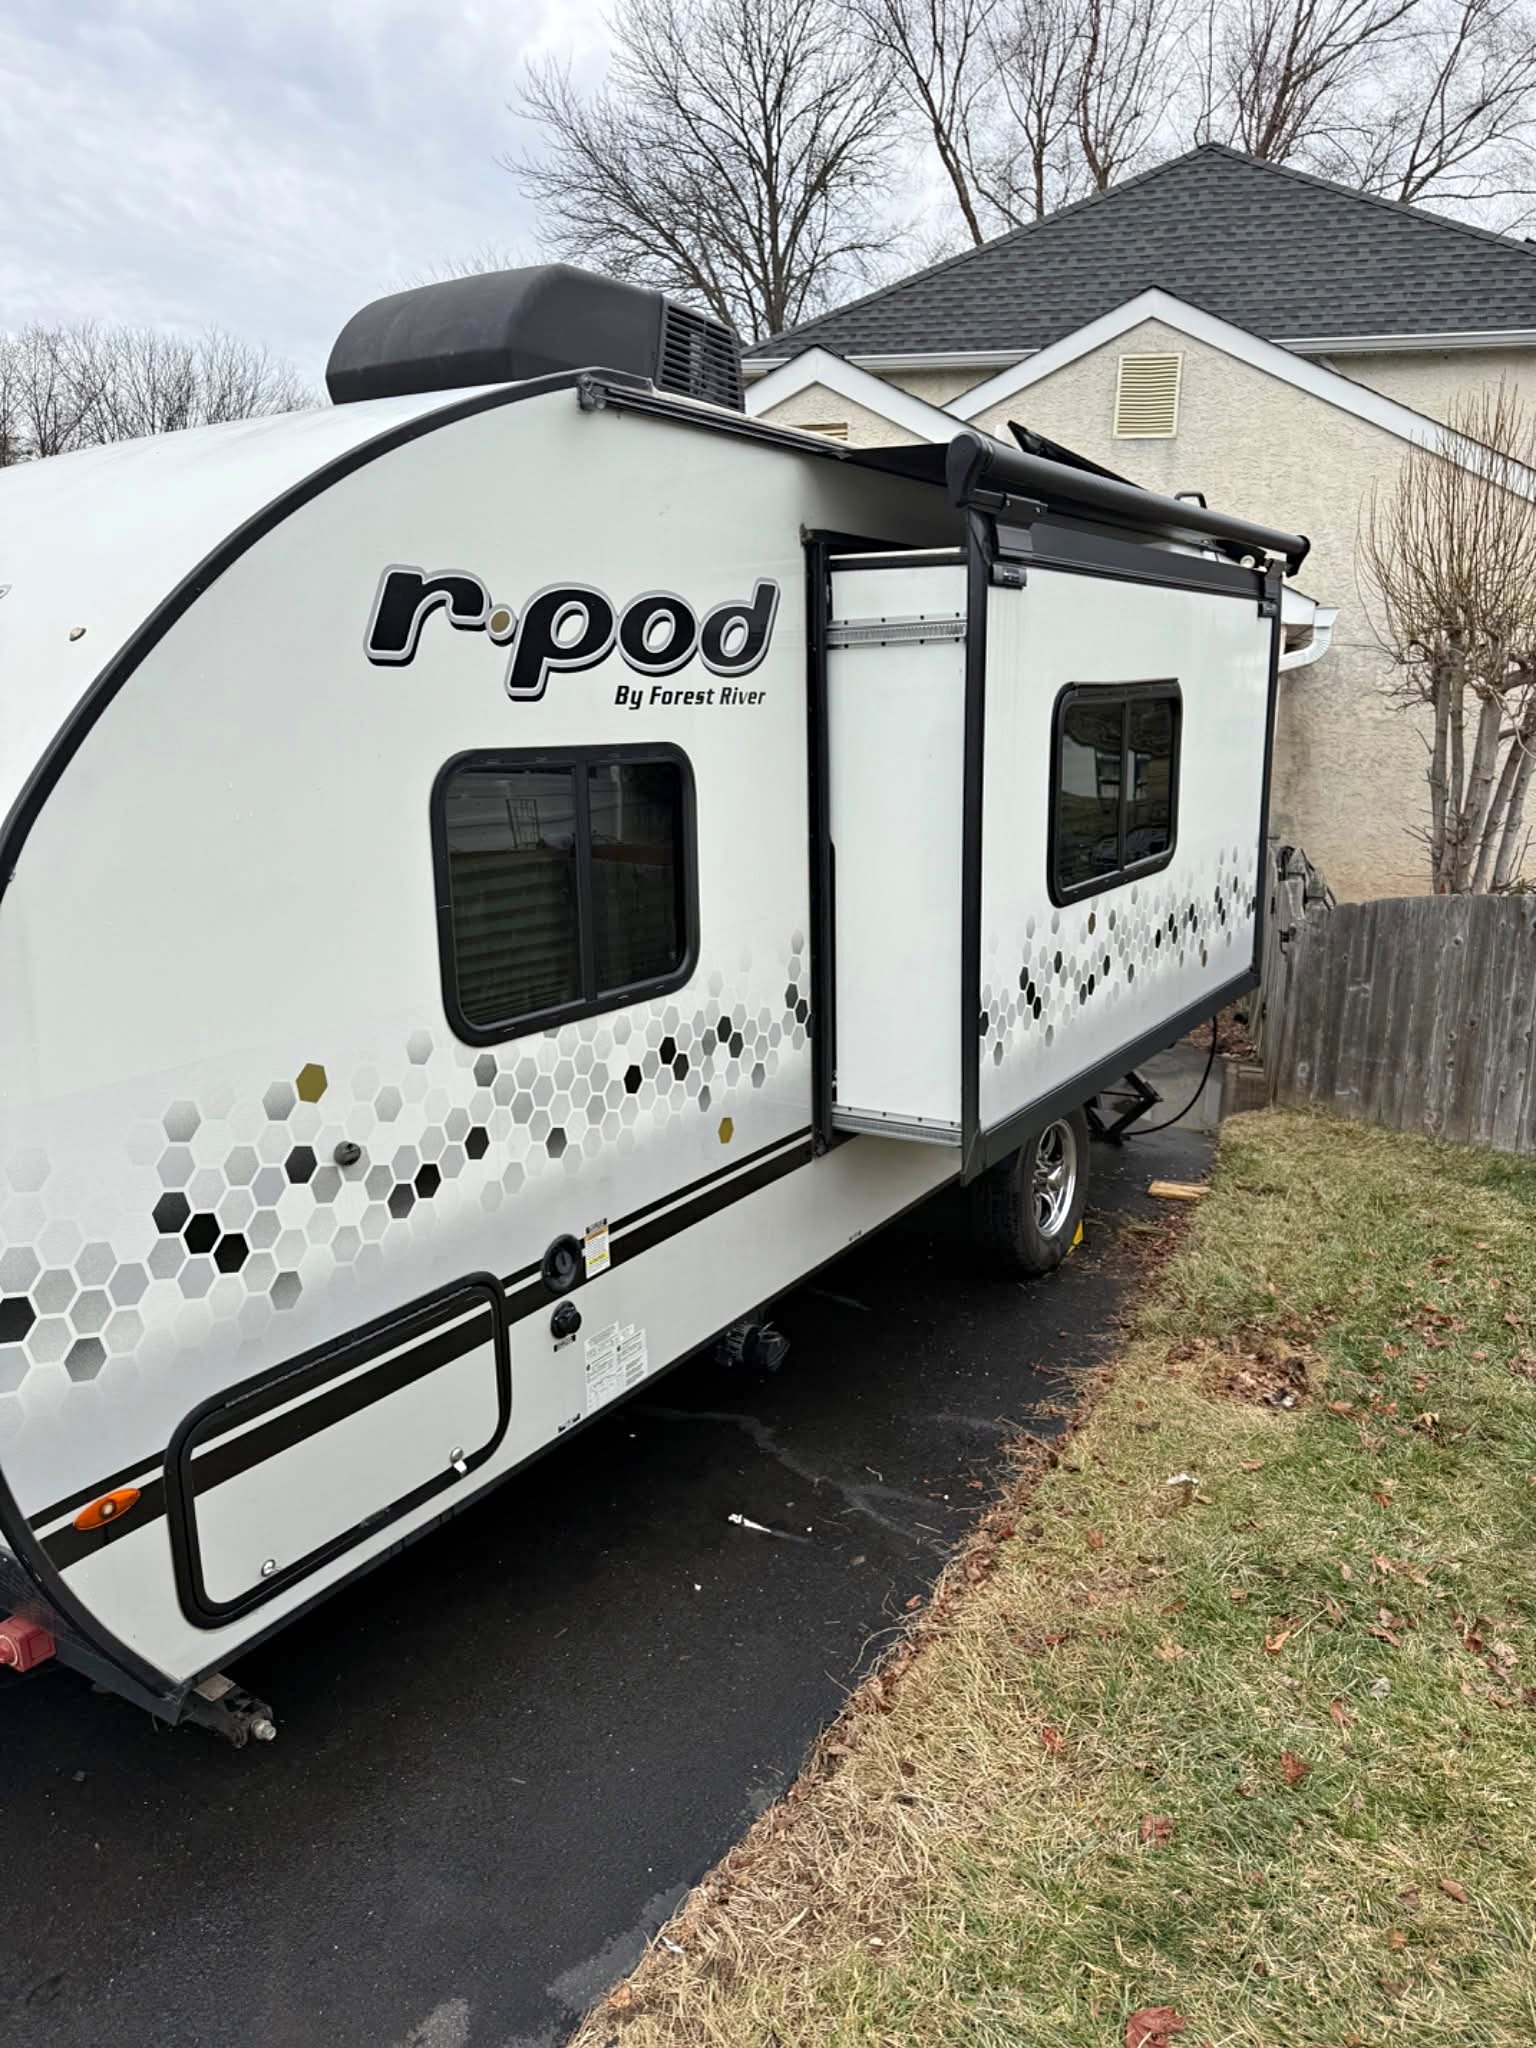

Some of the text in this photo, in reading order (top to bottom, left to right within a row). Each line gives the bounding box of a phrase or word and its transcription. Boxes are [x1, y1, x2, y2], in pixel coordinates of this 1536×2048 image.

[615, 685, 766, 710] By Forest River
